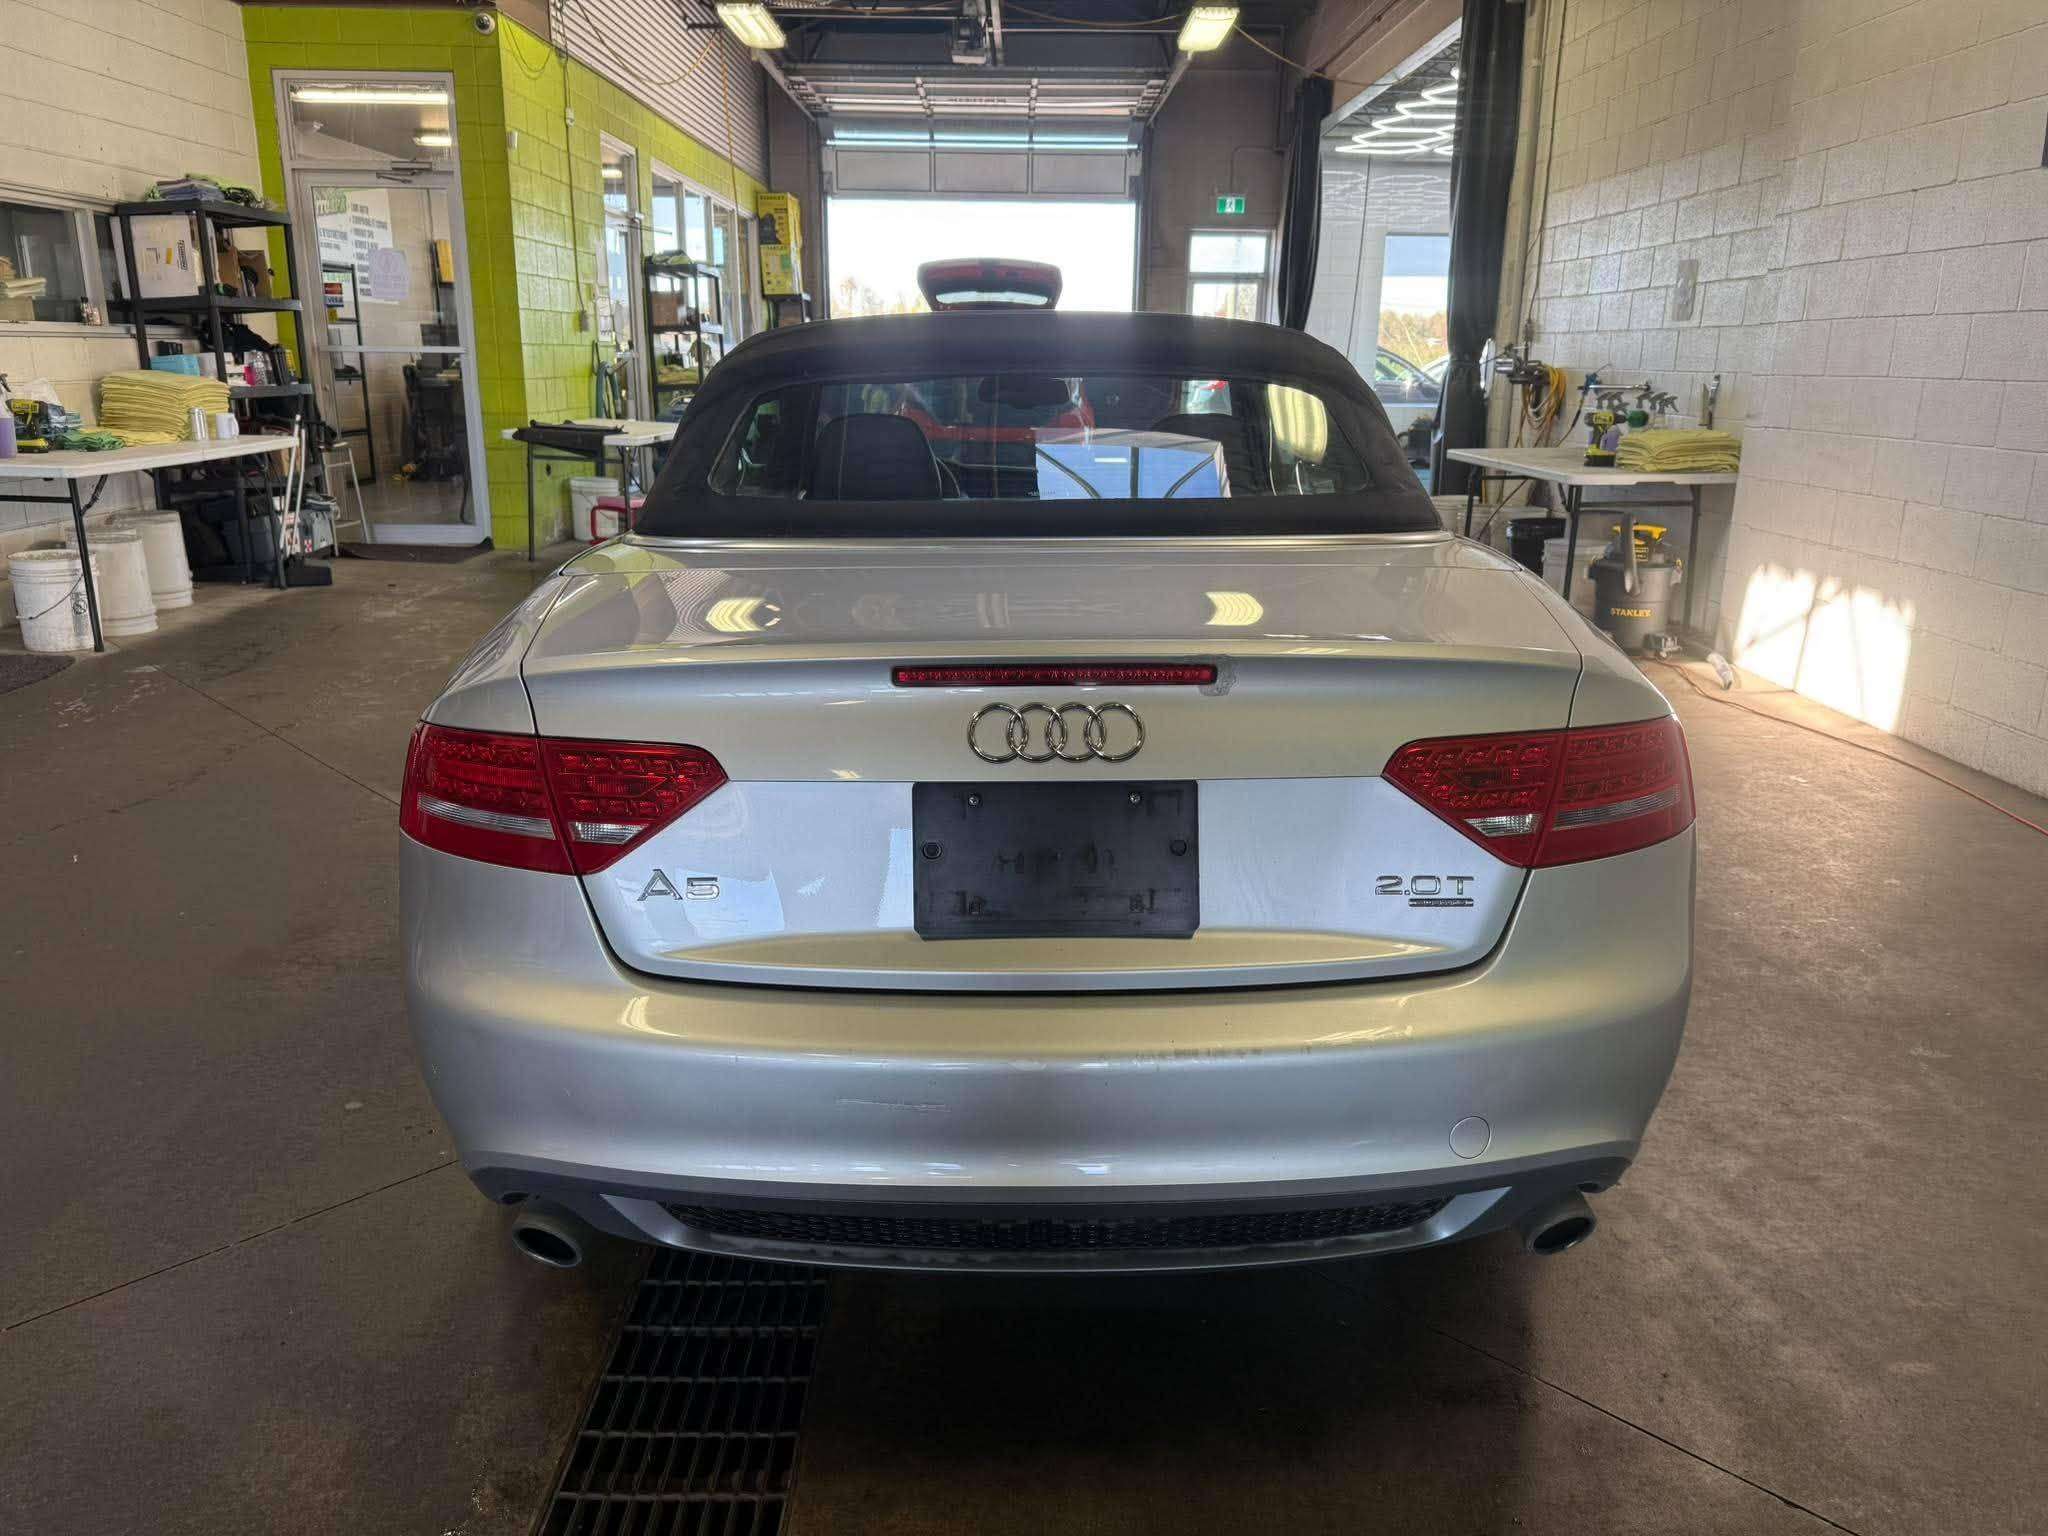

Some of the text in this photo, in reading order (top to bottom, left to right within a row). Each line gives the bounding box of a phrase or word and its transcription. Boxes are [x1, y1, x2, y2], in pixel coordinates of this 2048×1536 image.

[1610, 607, 1652, 617] STANLEY
[637, 868, 720, 901] A5
[1375, 875, 1475, 896] 2.0T
